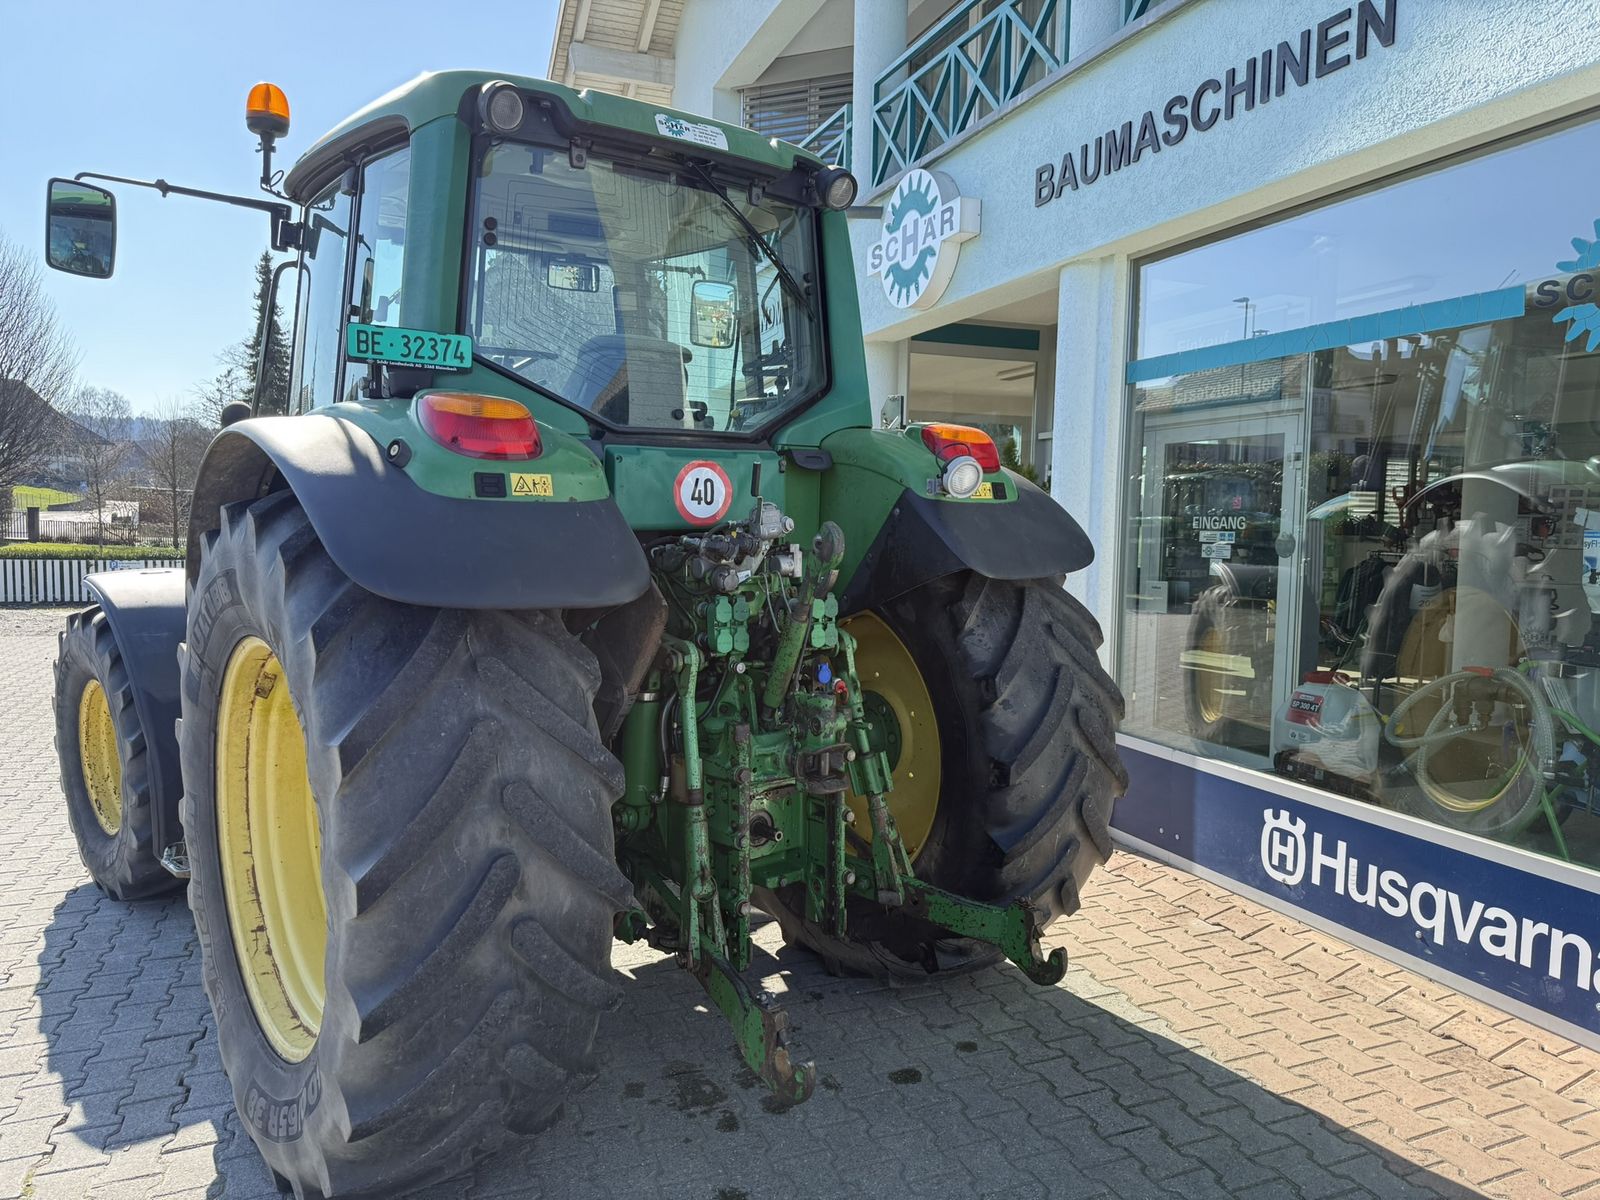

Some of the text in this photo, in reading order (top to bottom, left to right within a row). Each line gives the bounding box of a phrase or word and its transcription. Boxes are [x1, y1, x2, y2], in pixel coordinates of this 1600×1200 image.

[1035, 0, 1396, 207] BAUMASCHINEN
[871, 205, 955, 270] SCHÄR
[356, 329, 465, 364] BE 32374
[690, 477, 715, 506] 40
[1192, 516, 1246, 530] EINGANG
[1311, 831, 1600, 993] Husqvarn
